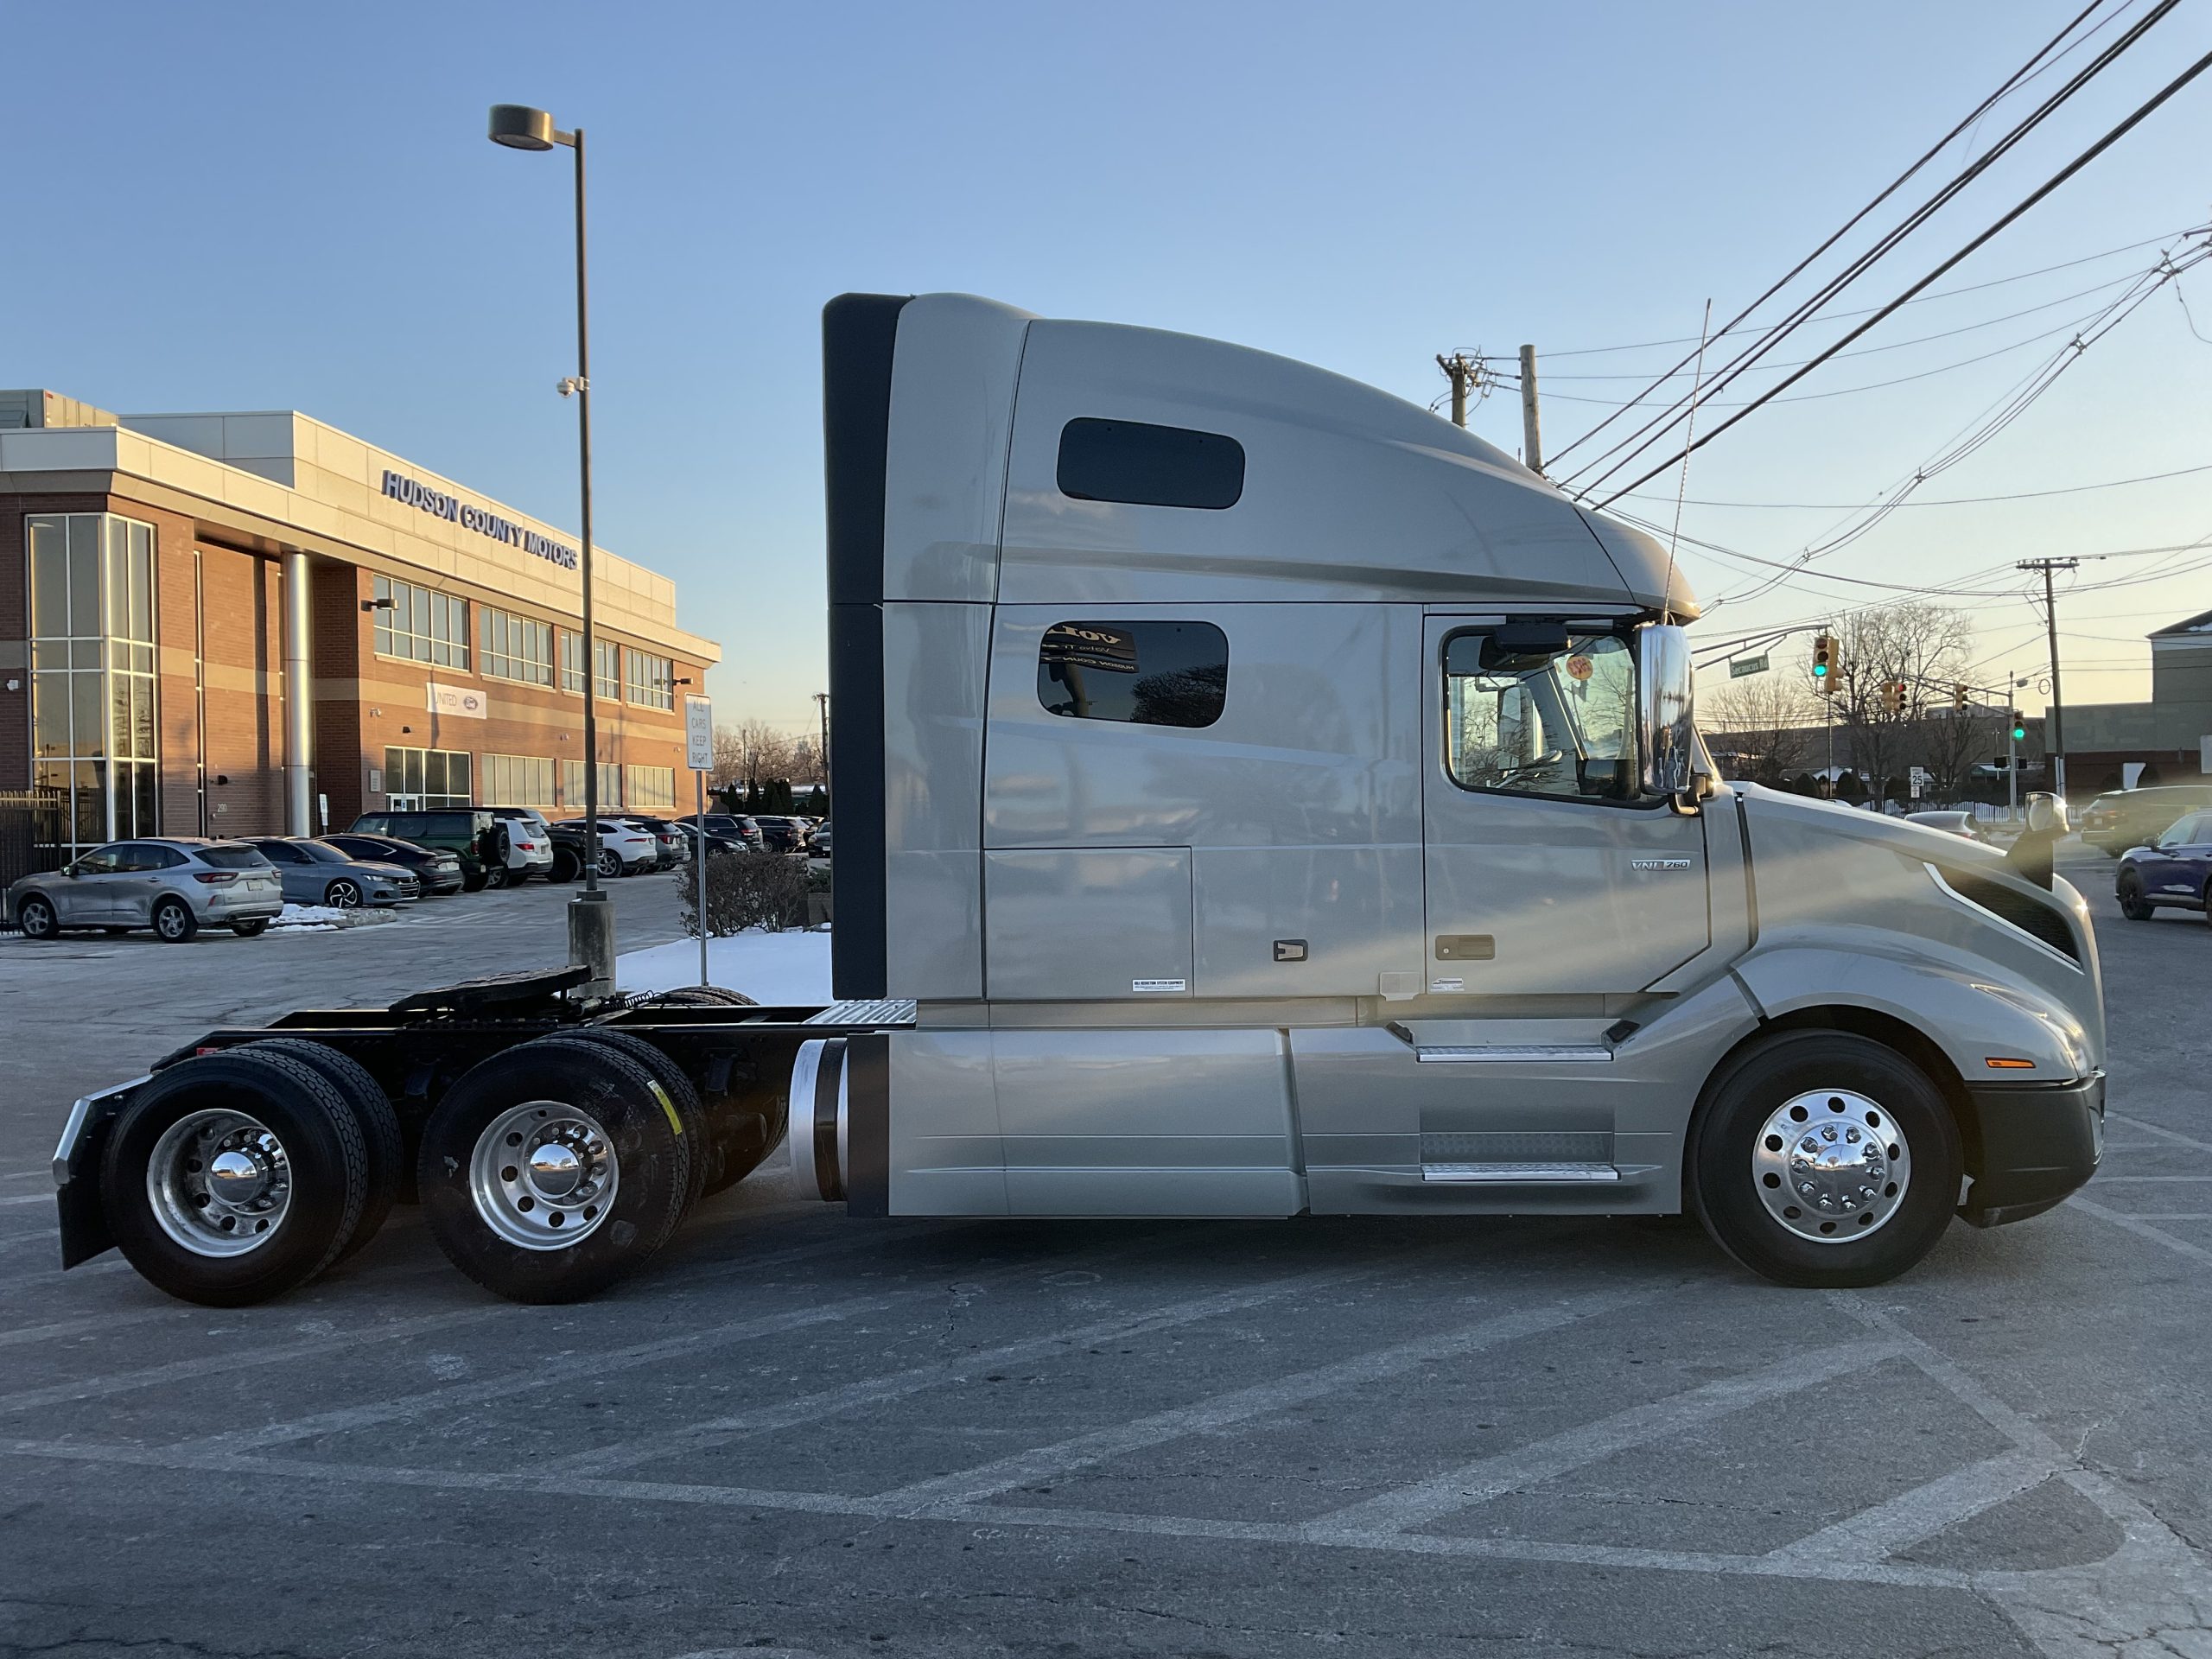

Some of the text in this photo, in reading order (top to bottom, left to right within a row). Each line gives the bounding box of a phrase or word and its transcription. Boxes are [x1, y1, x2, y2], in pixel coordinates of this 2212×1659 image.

[381, 469, 578, 570] HUDSON COUNTY MOTORS
[1731, 658, 1768, 675] Secaucus Rd
[435, 691, 457, 707] UNITED
[692, 700, 704, 712] ALL
[691, 718, 706, 729] CARS
[691, 735, 707, 747] KEEP
[691, 752, 708, 764] RIGHT
[1912, 775, 1923, 785] 25
